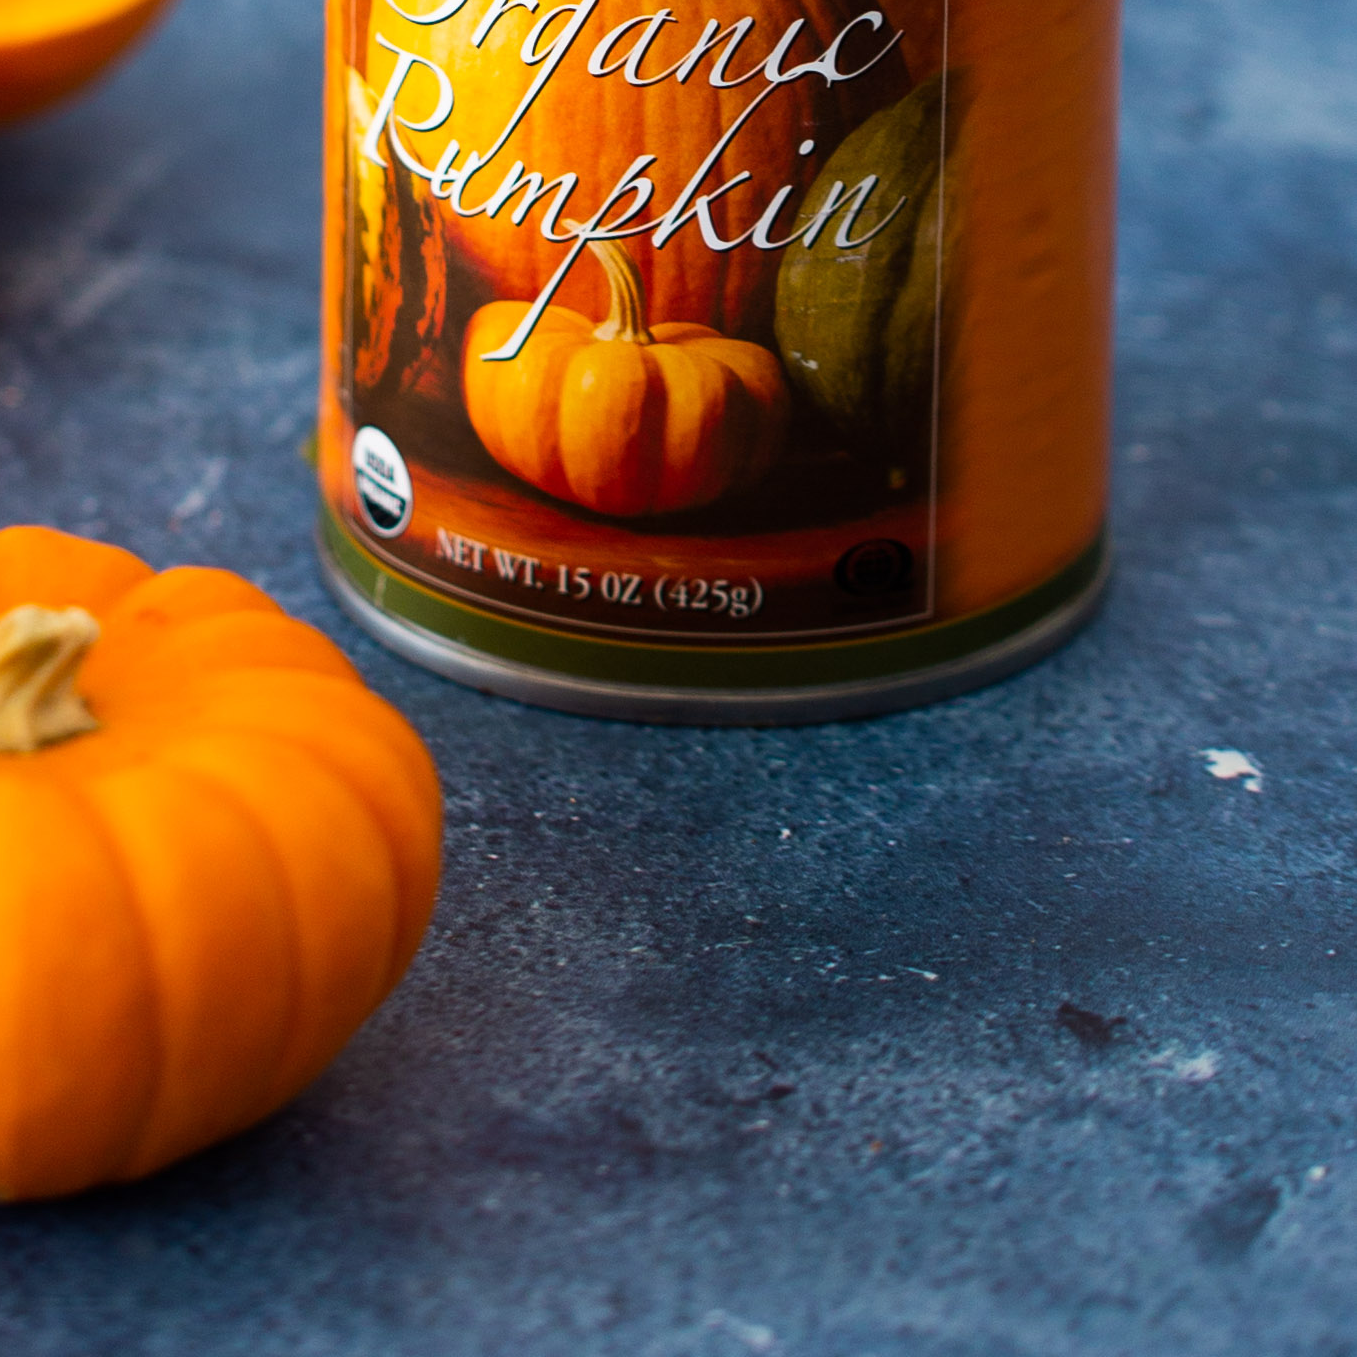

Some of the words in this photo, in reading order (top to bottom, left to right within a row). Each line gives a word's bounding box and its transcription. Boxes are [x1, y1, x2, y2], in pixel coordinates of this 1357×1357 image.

[363, 32, 908, 362] Pumpkin
[436, 526, 487, 572] NET
[492, 546, 544, 590] WT.
[557, 564, 591, 601] 15
[600, 571, 643, 606] OZ
[654, 574, 764, 619] (425g)
